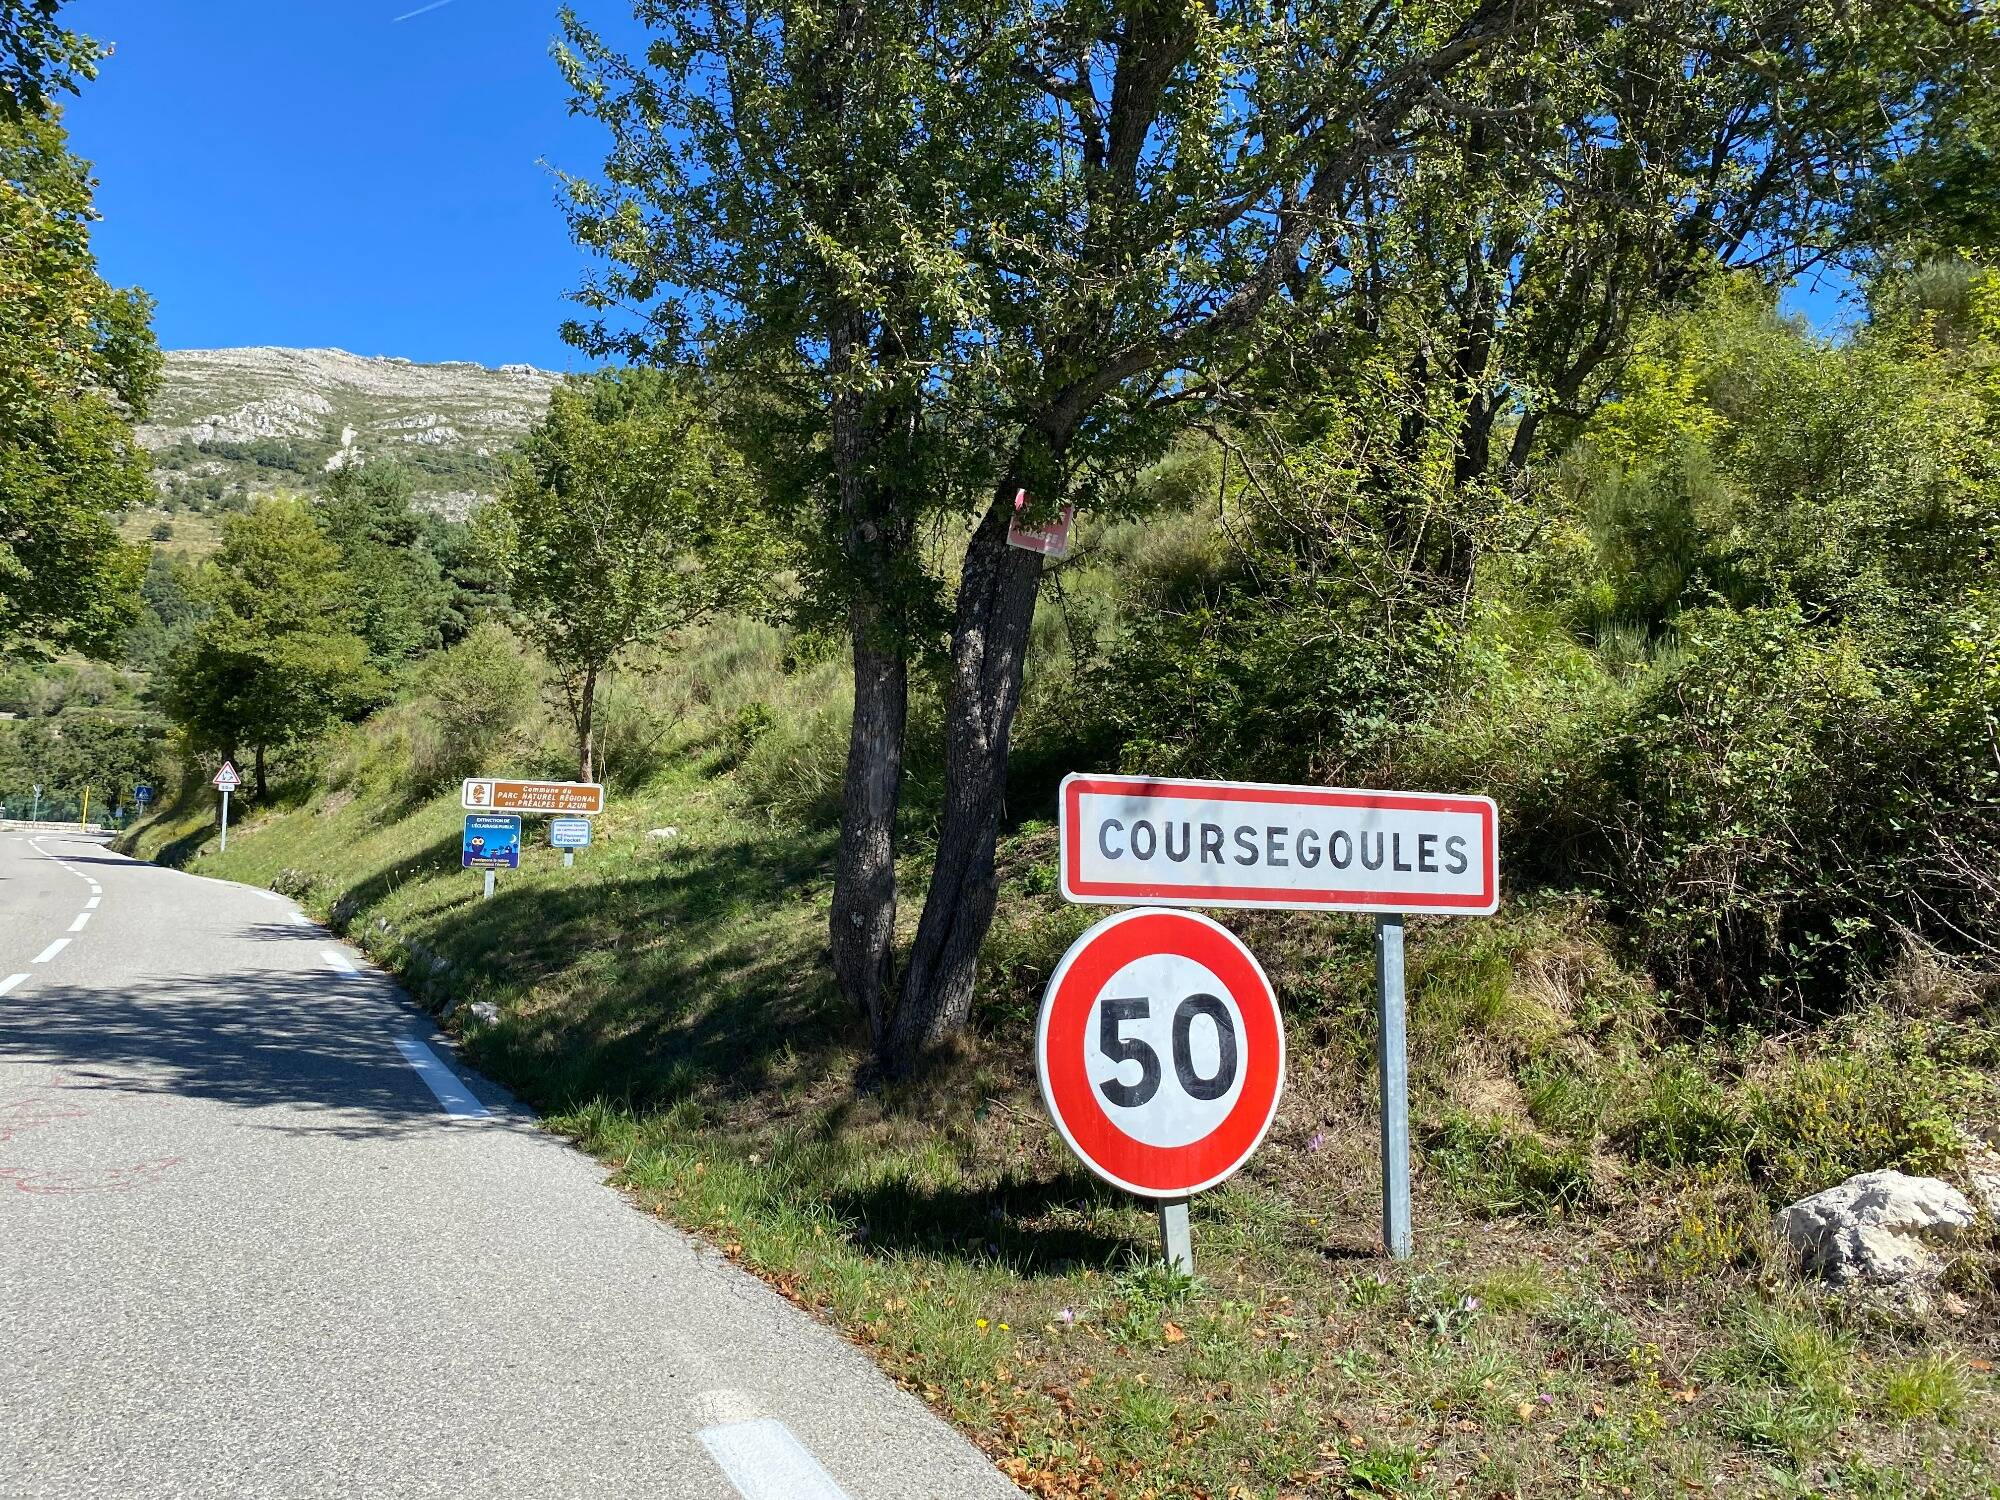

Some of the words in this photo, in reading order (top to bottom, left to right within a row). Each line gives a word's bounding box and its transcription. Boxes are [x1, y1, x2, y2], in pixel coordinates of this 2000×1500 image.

[523, 786, 559, 794] Commune
[522, 793, 556, 801] NATUREL
[560, 794, 597, 802] RÉGIONAL
[517, 799, 556, 807] PRÉALPES
[1098, 818, 1468, 875] COURSEGOULES
[1098, 993, 1238, 1108] 50
